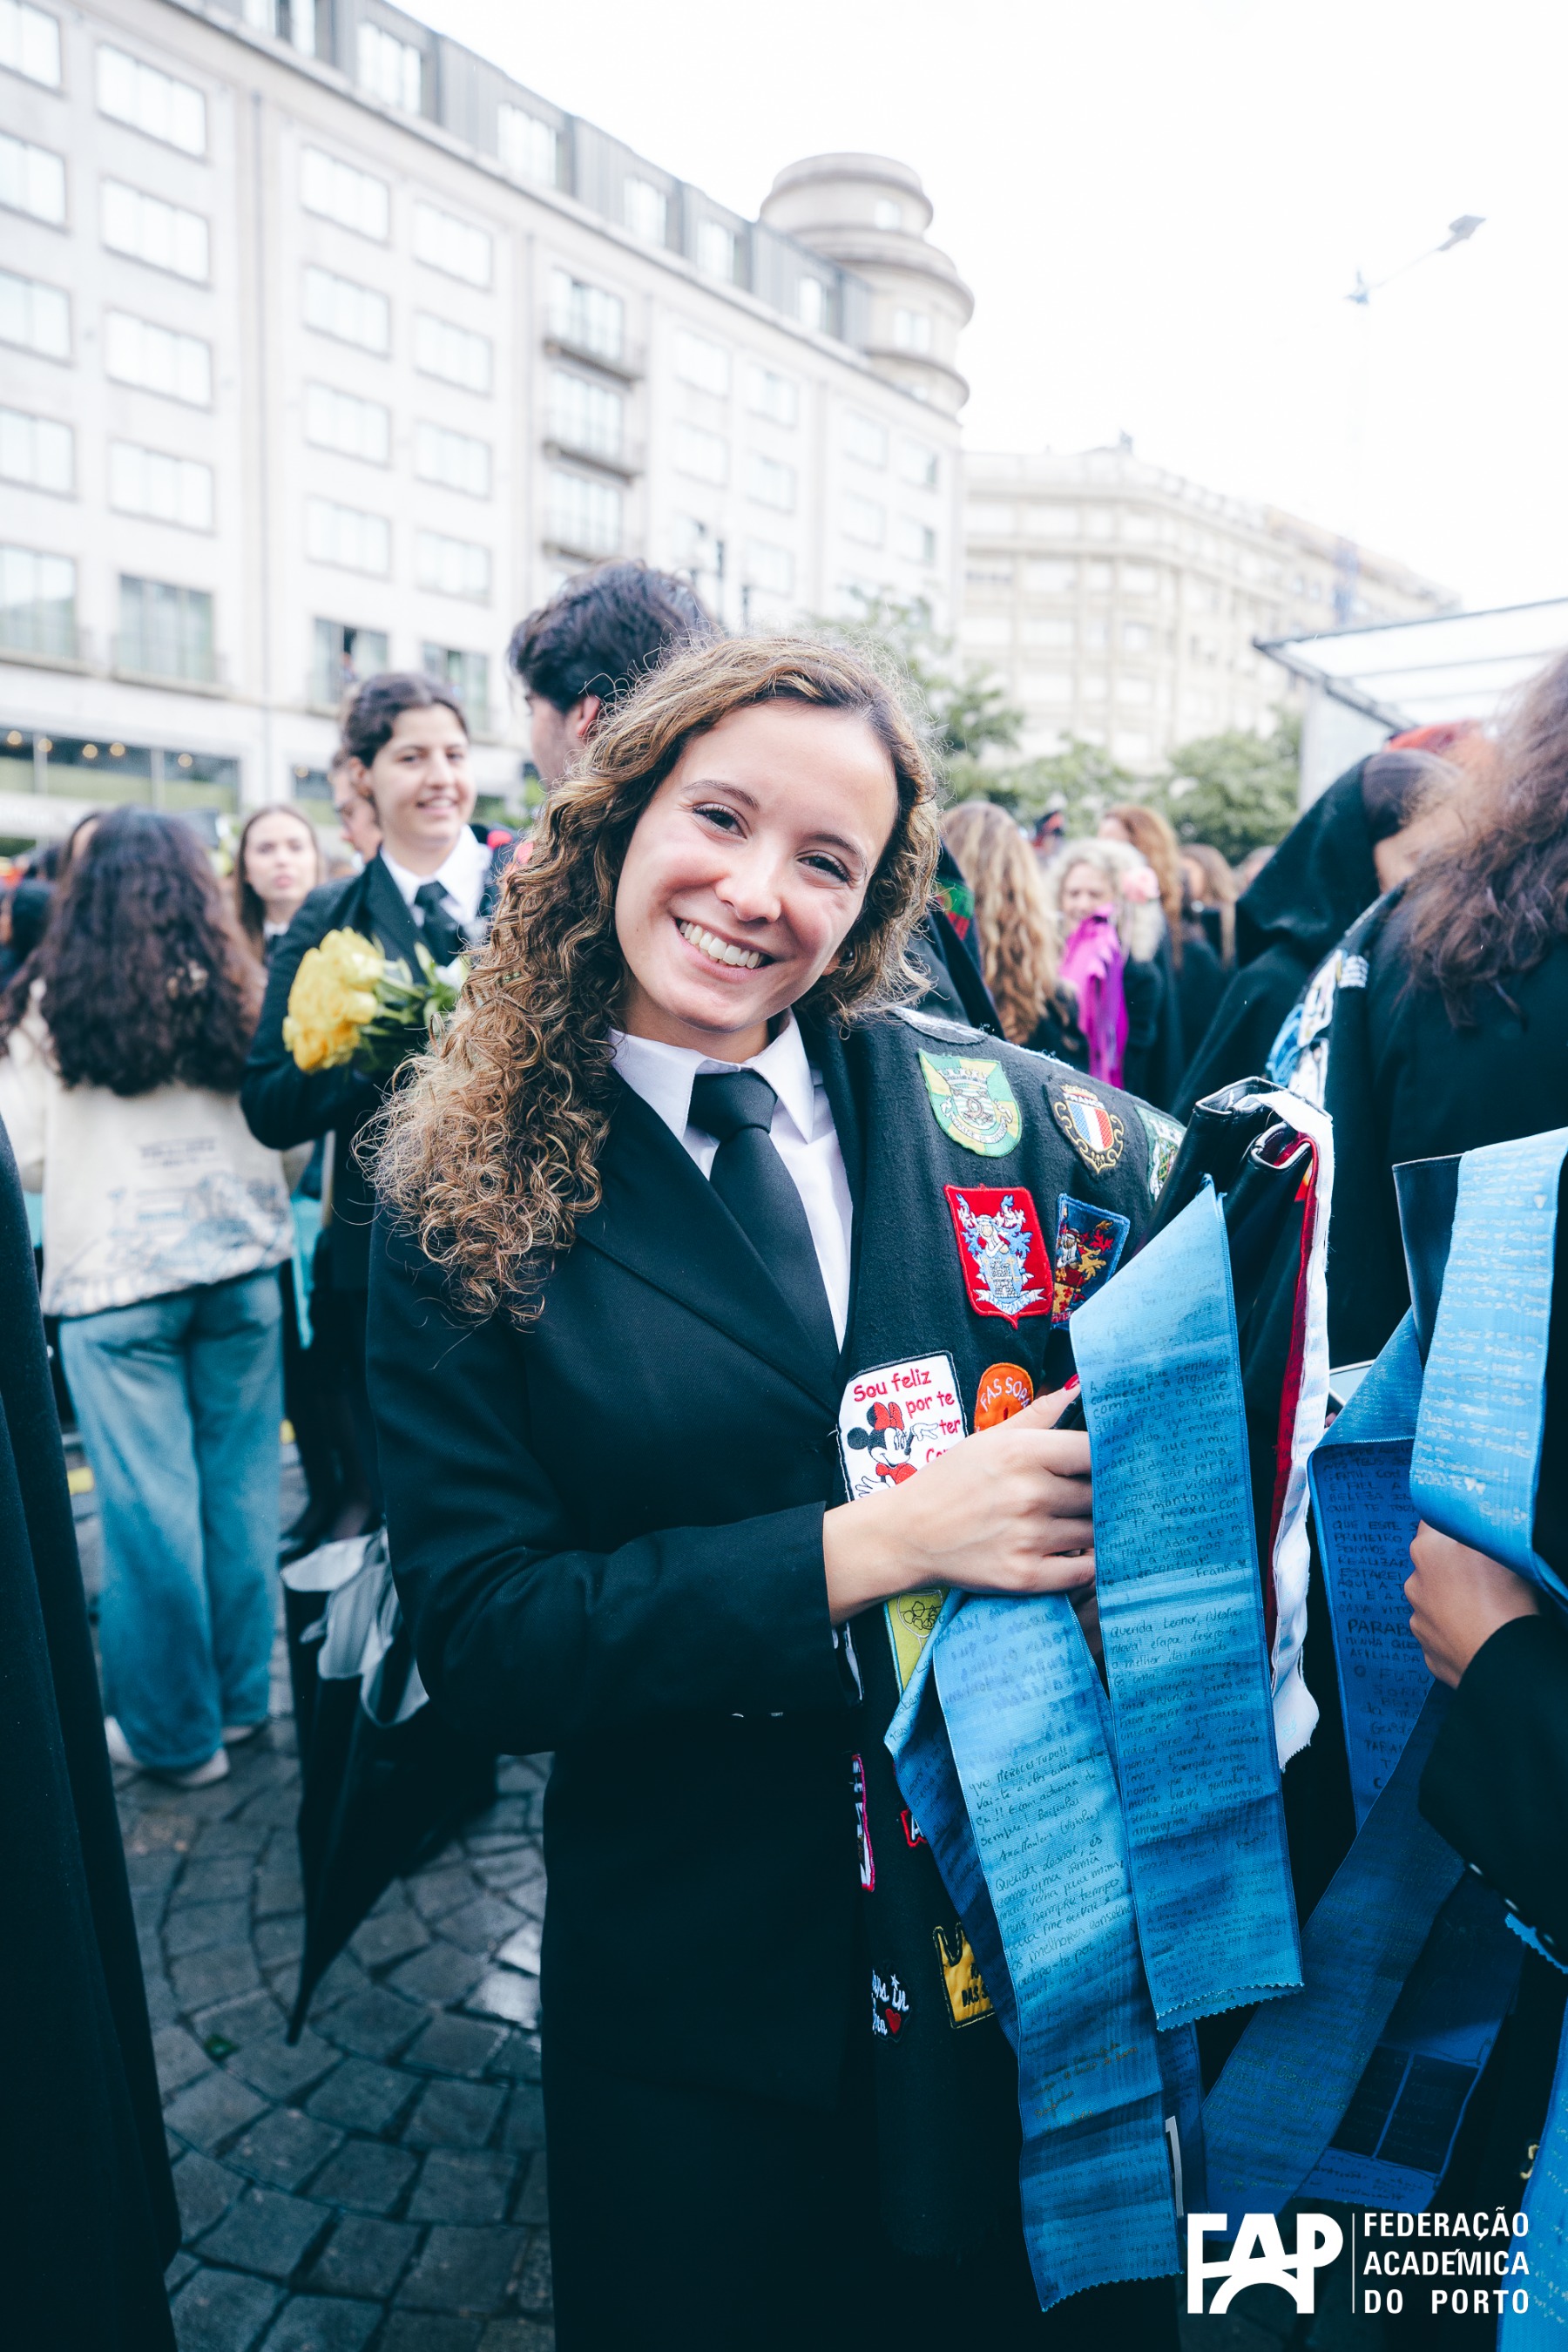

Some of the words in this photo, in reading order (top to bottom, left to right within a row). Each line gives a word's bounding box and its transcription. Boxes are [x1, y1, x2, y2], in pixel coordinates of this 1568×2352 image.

[1090, 1381, 1098, 1393] A
[1105, 1377, 1134, 1391] sorte
[1146, 1368, 1168, 1380] que
[1176, 1357, 1212, 1374] tenho
[853, 1381, 887, 1402] Sou
[890, 1368, 932, 1392] feliz
[1091, 1381, 1155, 1405] conhecer
[905, 1397, 933, 1420] por
[936, 1390, 956, 1408] te
[1092, 1398, 1131, 1420] como
[1189, 1380, 1229, 1397] sorte
[940, 1419, 961, 1436] ter
[1094, 1416, 1119, 1438] que
[1126, 1403, 1171, 1423] desejo
[1188, 1420, 1221, 1434] mais
[1161, 1437, 1188, 1456] que
[1195, 1449, 1227, 1462] uma
[1099, 1478, 1149, 1499] mulher
[1194, 1459, 1234, 1475] forte
[1124, 1484, 1176, 1505] consigo
[1116, 1505, 1145, 1521] uma
[1152, 1488, 1228, 1511] montanha
[1326, 1504, 1357, 1513] QUE
[1332, 1520, 1360, 1531] QUE
[1335, 1532, 1402, 1544] PRIMEIRO
[1163, 1548, 1192, 1562] vida
[1198, 1541, 1222, 1552] nos
[1335, 1543, 1387, 1555] SONHOS
[1337, 1554, 1410, 1569] REALIZAR
[1337, 1577, 1368, 1588] AQUI
[1339, 1568, 1402, 1581] ESTAREI
[1367, 1591, 1376, 1600] E
[1111, 1619, 1153, 1638] Querida
[1125, 1655, 1160, 1668] melhor
[1350, 1648, 1421, 1664] AFILHADA
[1354, 1664, 1367, 1678] O
[1156, 1690, 1198, 1705] Nunca
[995, 1862, 1038, 1891] Querida
[1089, 1833, 1102, 1847] és
[997, 1887, 1028, 1909] como
[962, 1984, 980, 2007] DAS
